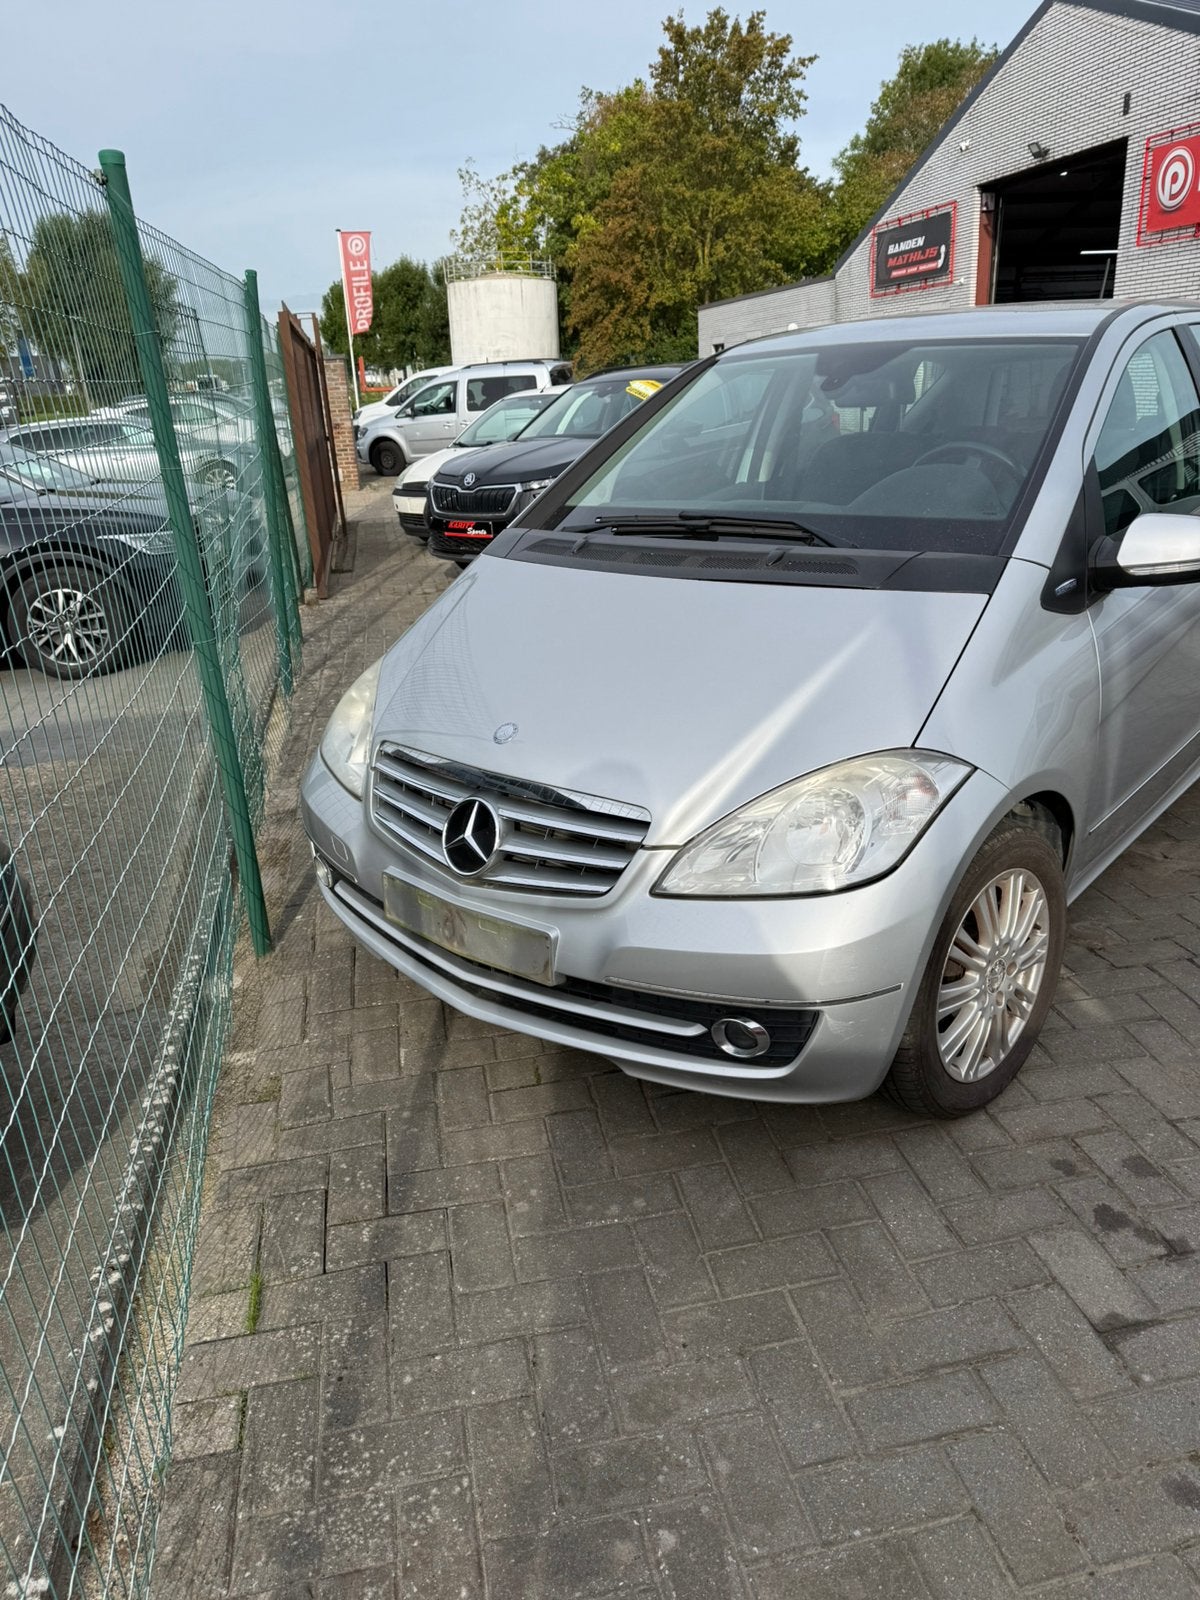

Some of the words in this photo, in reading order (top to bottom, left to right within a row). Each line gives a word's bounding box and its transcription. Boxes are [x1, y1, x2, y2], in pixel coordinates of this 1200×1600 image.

[887, 236, 925, 255] BANDEN
[887, 246, 939, 267] MATHIJS
[350, 260, 373, 331] PROFILE
